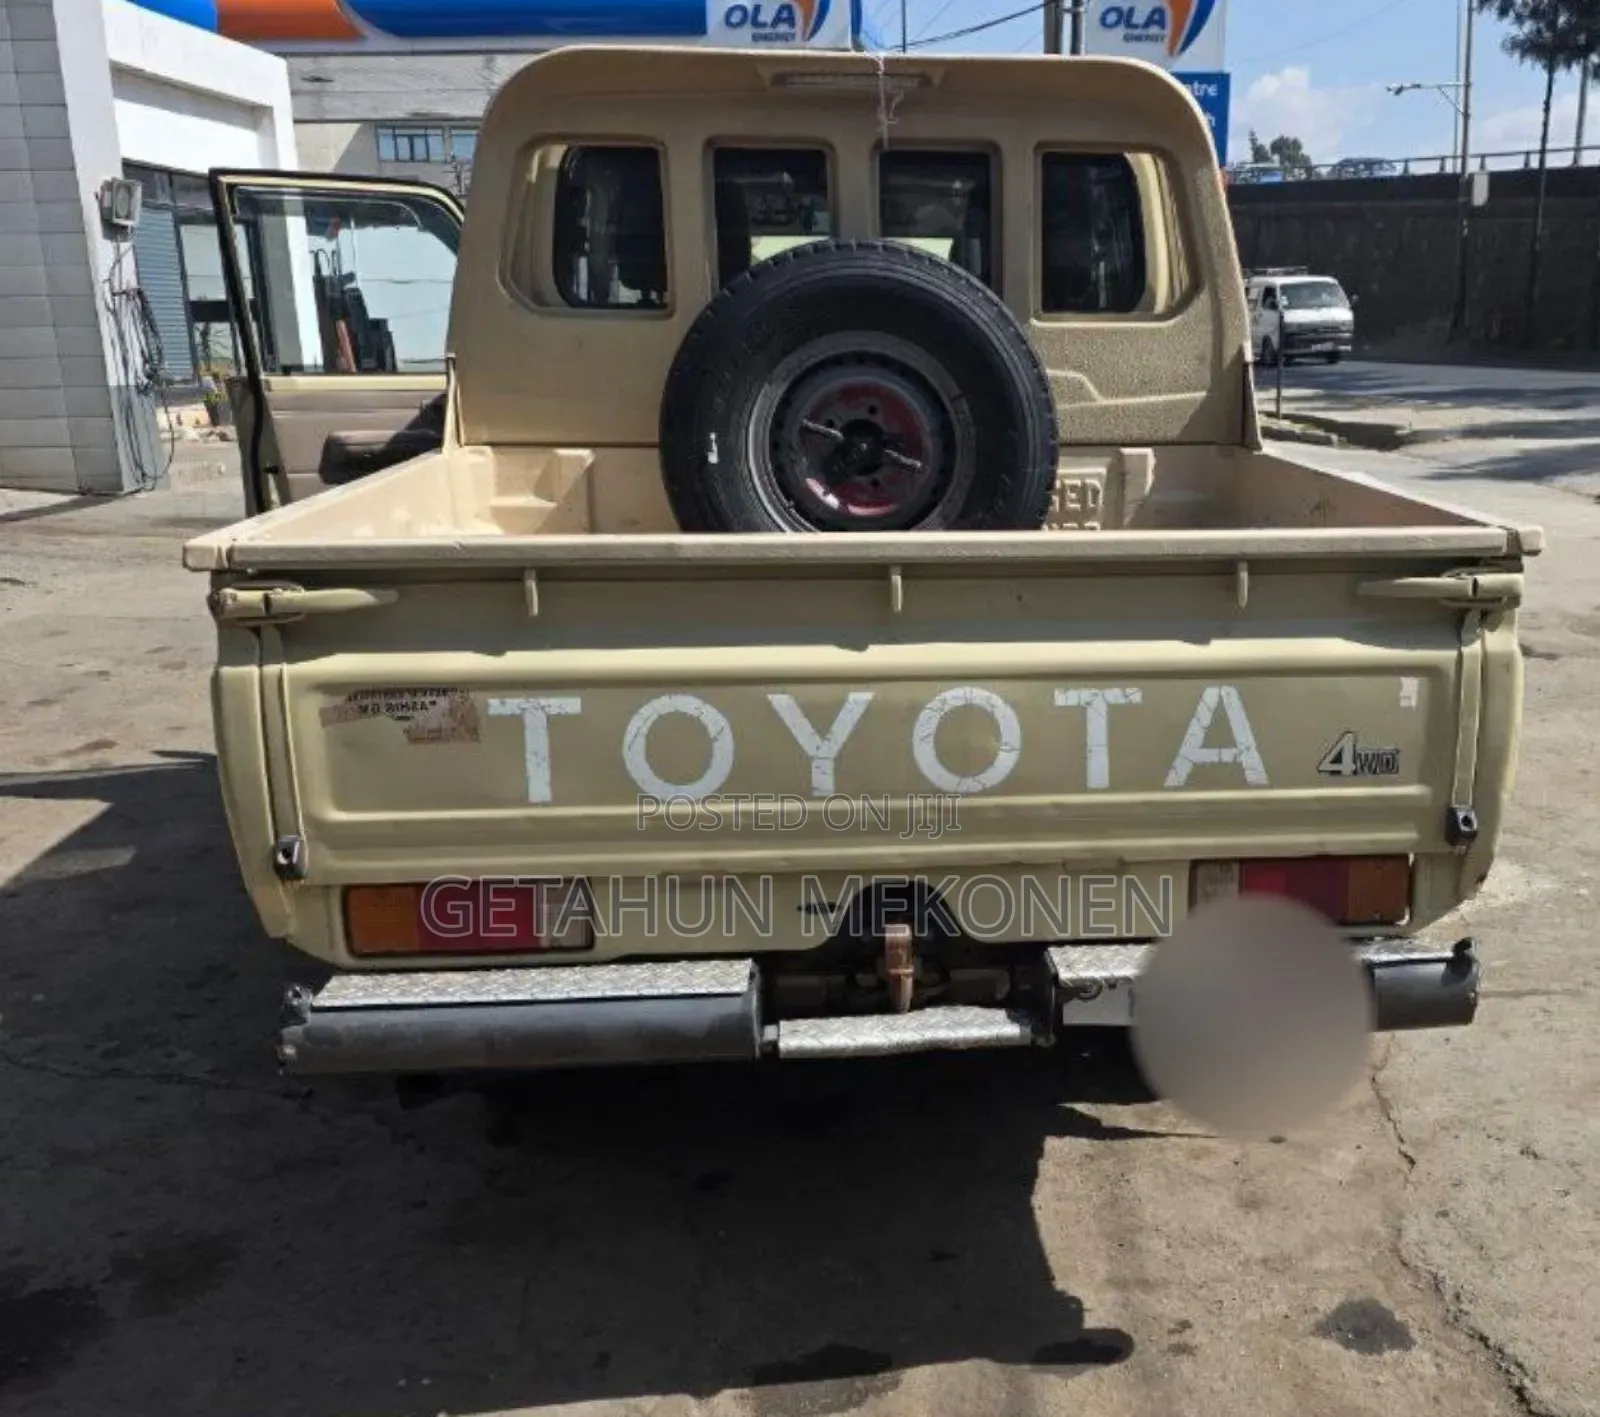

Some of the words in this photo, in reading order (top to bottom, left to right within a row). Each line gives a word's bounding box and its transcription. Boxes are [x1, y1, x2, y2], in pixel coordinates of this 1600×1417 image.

[725, 4, 795, 29] OLA
[1099, 6, 1166, 29] OLA
[487, 685, 1268, 804] TOYOTA
[1316, 731, 1400, 776] 4WD
